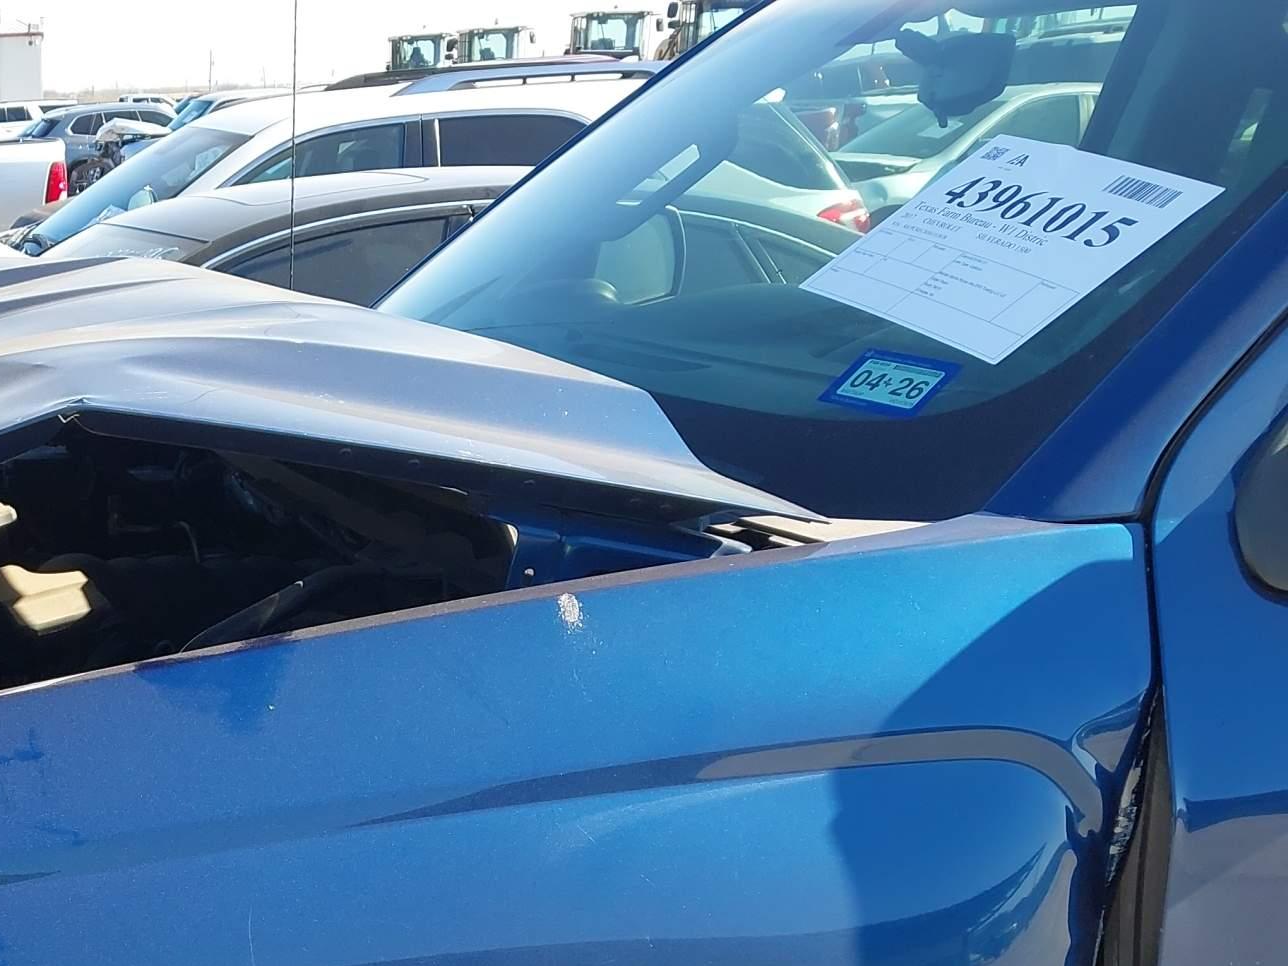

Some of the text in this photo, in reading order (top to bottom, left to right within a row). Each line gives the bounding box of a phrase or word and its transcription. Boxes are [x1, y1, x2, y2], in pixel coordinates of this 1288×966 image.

[914, 200, 937, 214] Texas
[937, 206, 961, 220] Farm
[960, 213, 993, 229] Bureau
[944, 176, 1139, 248] 43961015
